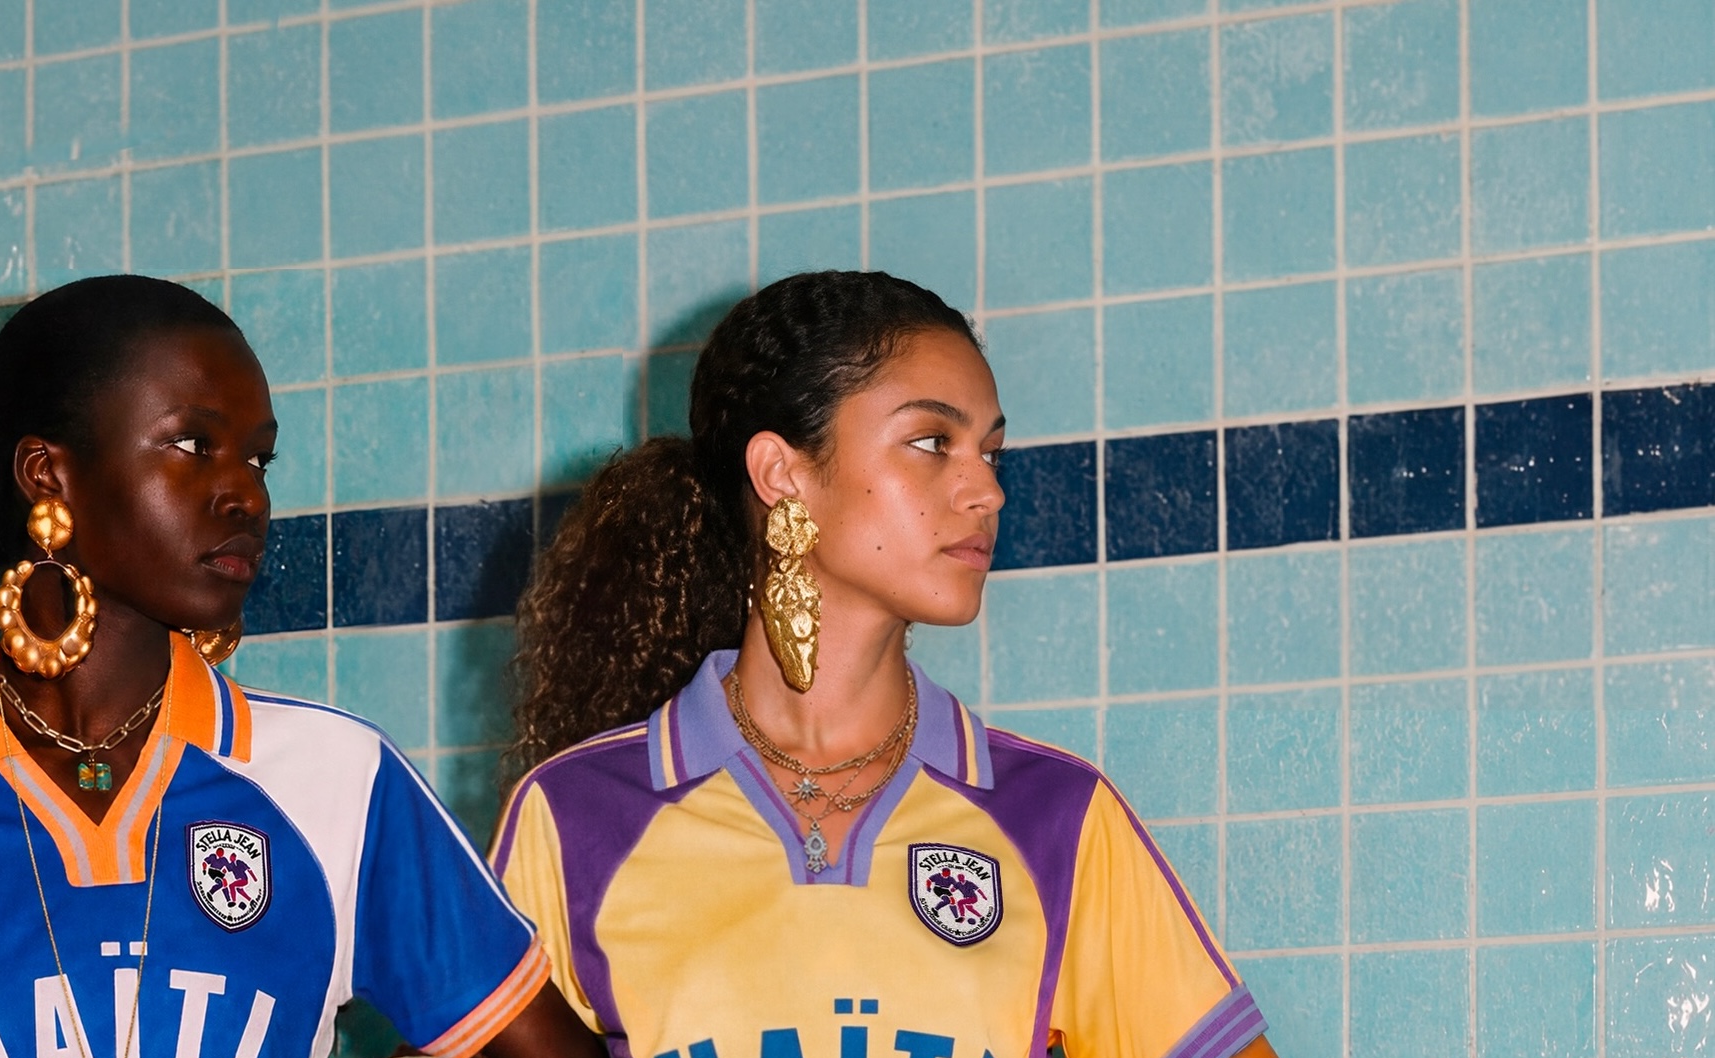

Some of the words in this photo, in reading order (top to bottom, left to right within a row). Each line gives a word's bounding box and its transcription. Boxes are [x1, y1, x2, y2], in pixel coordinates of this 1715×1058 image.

[196, 829, 232, 852] STELLA
[234, 834, 261, 859] JEAN
[919, 852, 960, 872] STELLA
[962, 858, 990, 880] JEAN
